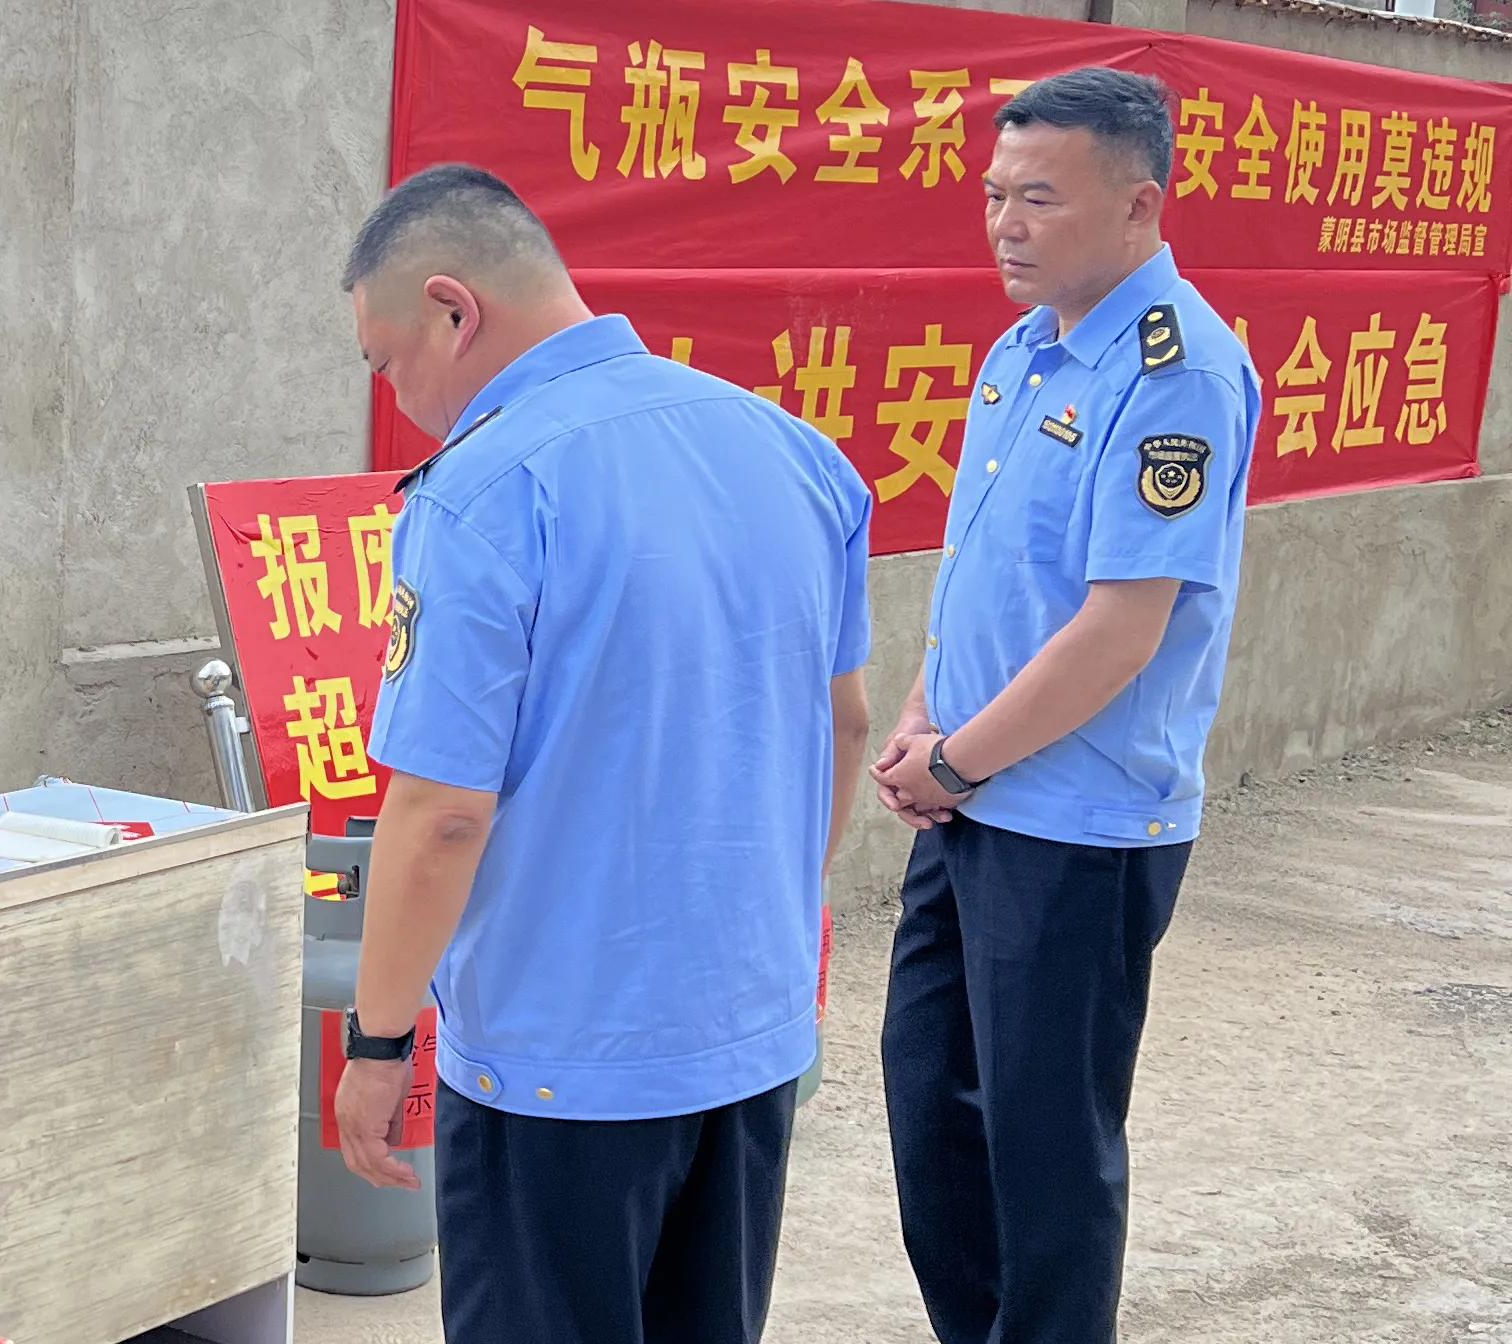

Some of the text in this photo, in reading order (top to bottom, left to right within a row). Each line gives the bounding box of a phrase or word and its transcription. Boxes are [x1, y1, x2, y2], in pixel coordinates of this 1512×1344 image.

[512, 25, 1496, 213] 气瓶安全系 安全使用莫违规
[1317, 215, 1487, 257] 蒙阴县市场监督管理局宣
[671, 311, 1448, 504] 讲安 会应急
